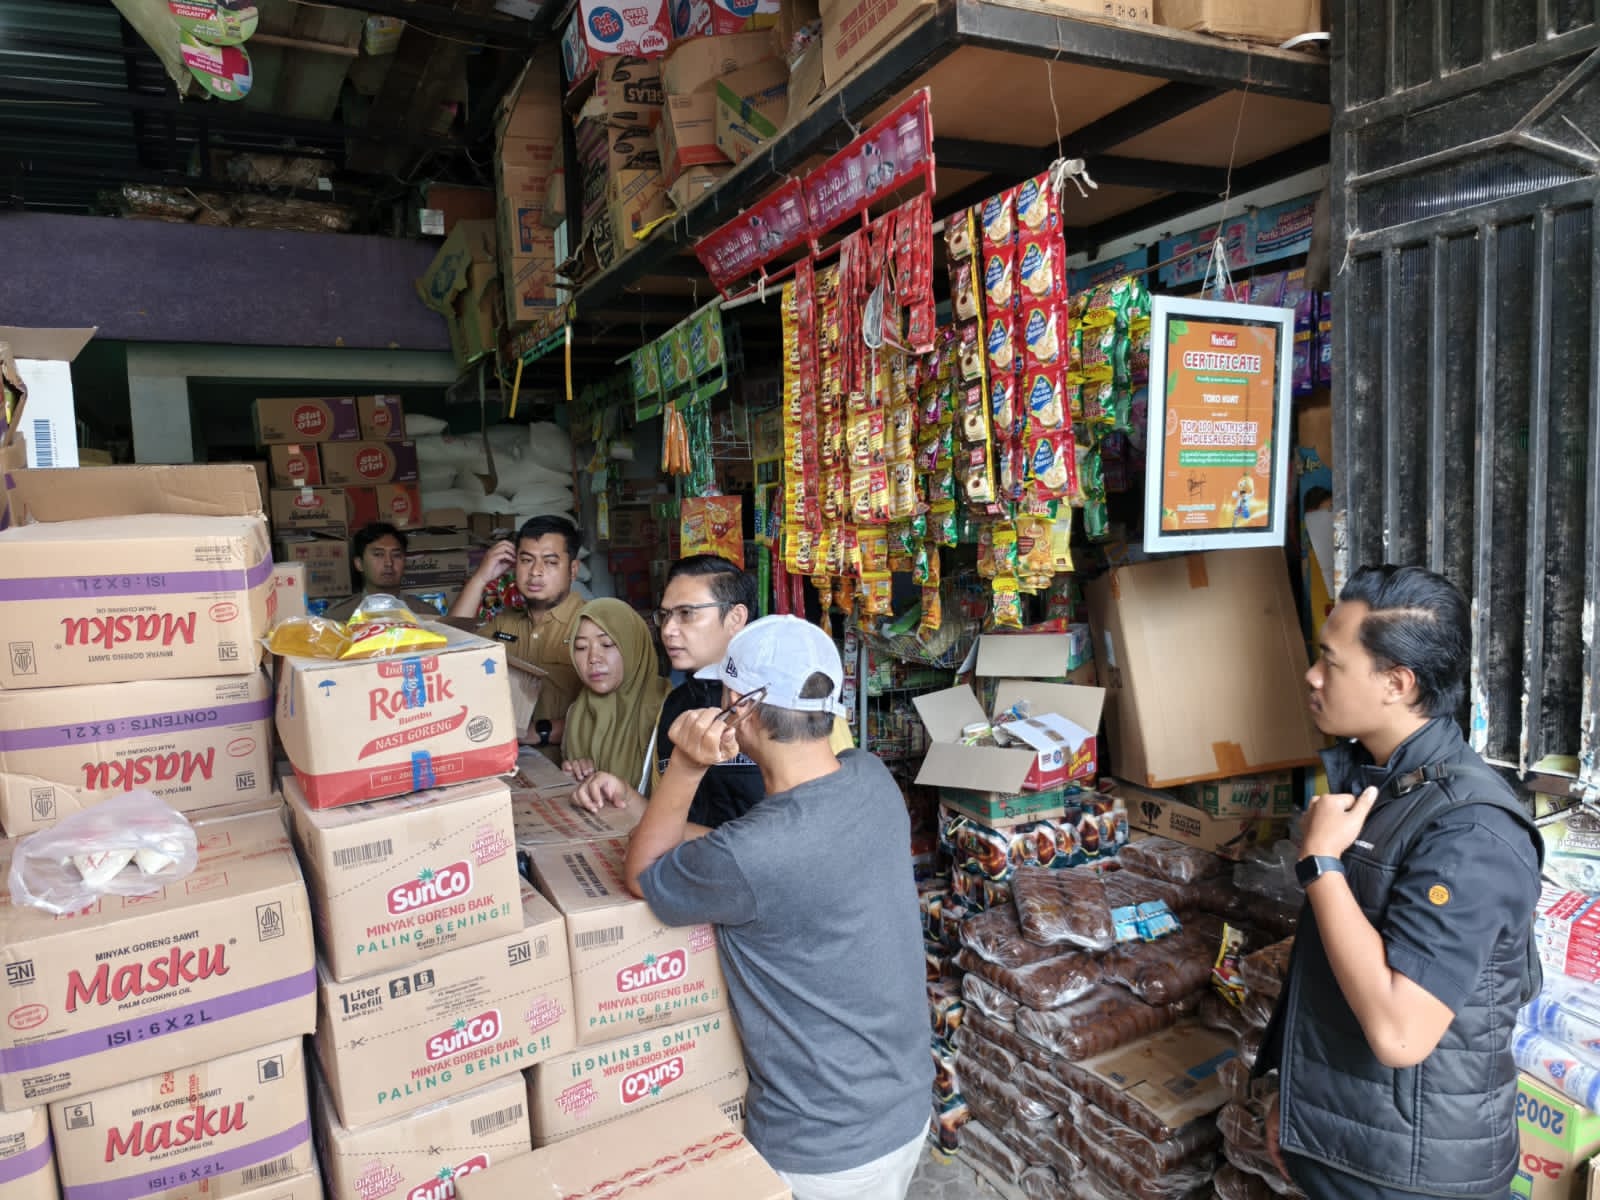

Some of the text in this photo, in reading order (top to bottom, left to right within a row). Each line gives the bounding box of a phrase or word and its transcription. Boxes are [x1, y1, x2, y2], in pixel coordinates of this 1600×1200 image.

[1183, 352, 1261, 372] CERTIFICATE
[1181, 421, 1197, 432] TOP
[1181, 433, 1236, 445] WHOLESALERS
[147, 575, 166, 588] ISI
[60, 611, 197, 650] Masku
[112, 651, 144, 661] GORENG
[145, 649, 173, 658] MINYAK
[130, 709, 218, 732] CONTENTS
[375, 733, 404, 751] NASI
[407, 719, 453, 741] GORENG
[81, 746, 216, 792] Masku
[235, 773, 256, 790] SNI
[392, 869, 466, 911] SunCo
[366, 894, 496, 938] MINYAK GORENG BAIK
[95, 929, 200, 961] MINYAK GORENG SAWIT
[355, 929, 424, 956] PALING
[508, 943, 531, 963] SNI
[7, 963, 35, 981] SNI
[65, 943, 231, 1013] Masku
[420, 972, 430, 985] 6
[621, 953, 683, 989] SunCo
[117, 1000, 140, 1012] PALM
[140, 993, 179, 1008] COOKING
[339, 994, 349, 1014] 1
[350, 986, 381, 1003] Liter
[351, 996, 382, 1013] Refill
[598, 980, 706, 1012] MINYAK GORENG BAIK
[106, 1029, 132, 1047] ISI
[149, 1021, 161, 1036] 6
[165, 1016, 180, 1032] X
[182, 1013, 196, 1028] 2
[199, 1008, 213, 1023] L
[589, 1006, 646, 1028] PALING
[430, 1017, 496, 1058] SunCo
[661, 1018, 721, 1047] PALING
[410, 1036, 520, 1080] MINYAK GORENG BAIK
[602, 1040, 696, 1079] MINYAK GORENG BAIK
[376, 1071, 453, 1104] PALING
[624, 1062, 681, 1096] SunCo
[73, 1107, 83, 1117] 6
[131, 1087, 223, 1117] MINYAK GORENG SAWIT
[1515, 1091, 1565, 1135] 2003
[104, 1101, 249, 1163] Masku
[148, 1178, 167, 1191] ISI
[178, 1171, 188, 1181] 6
[191, 1168, 201, 1178] X
[203, 1164, 213, 1175] 2
[215, 1161, 225, 1172] L
